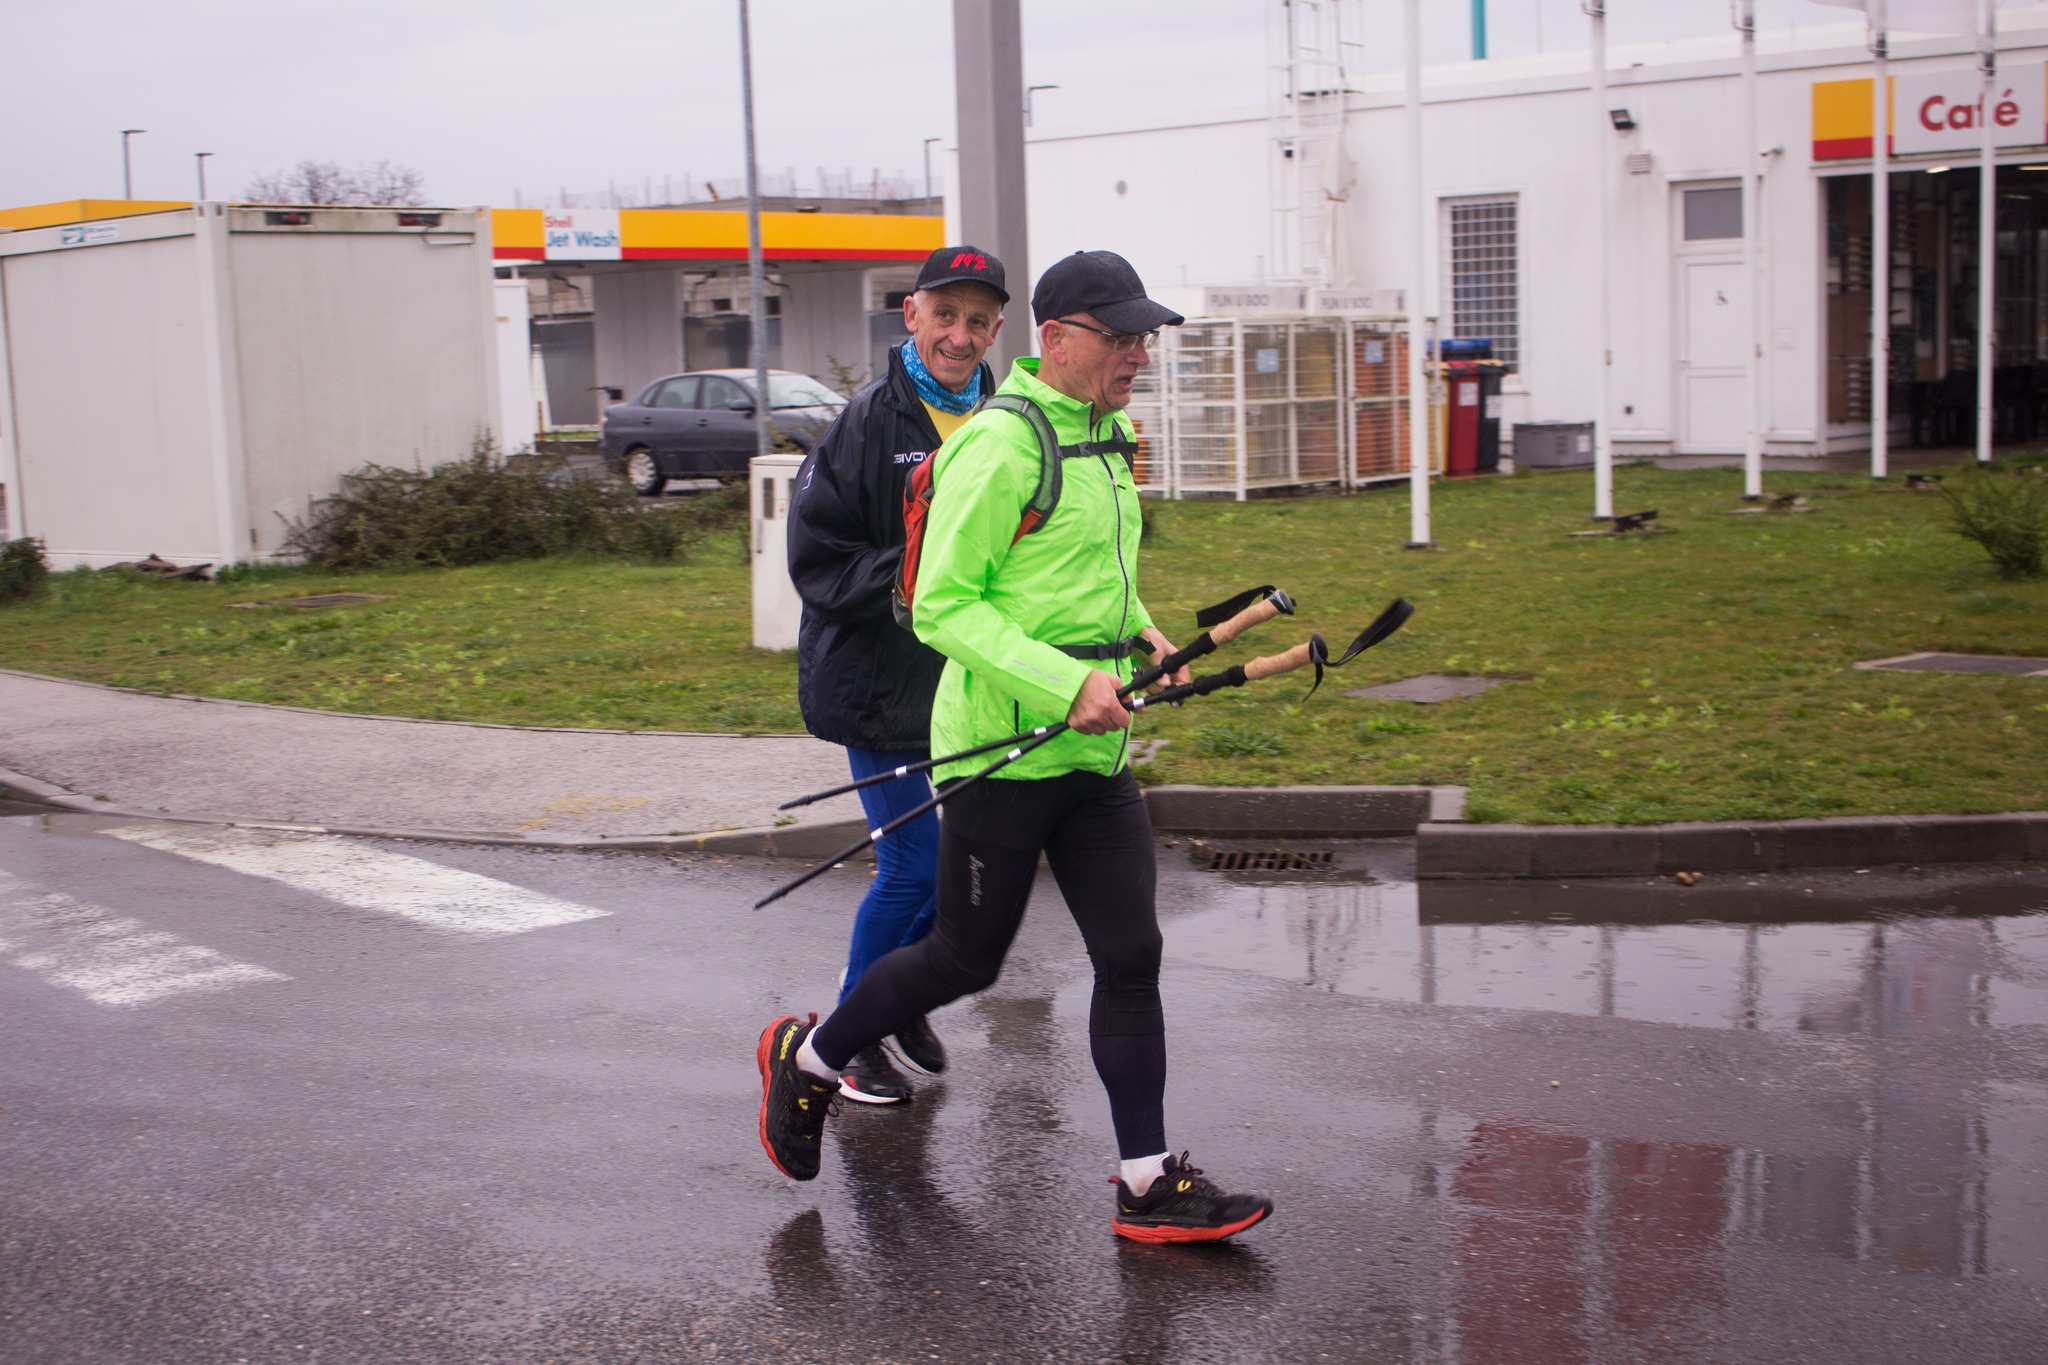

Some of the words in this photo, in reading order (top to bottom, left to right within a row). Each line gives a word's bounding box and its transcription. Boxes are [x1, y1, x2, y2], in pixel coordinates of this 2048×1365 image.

[544, 215, 573, 228] Shell
[546, 231, 570, 247] Jet
[573, 230, 619, 247] Wash
[893, 451, 932, 464] GIVOV
